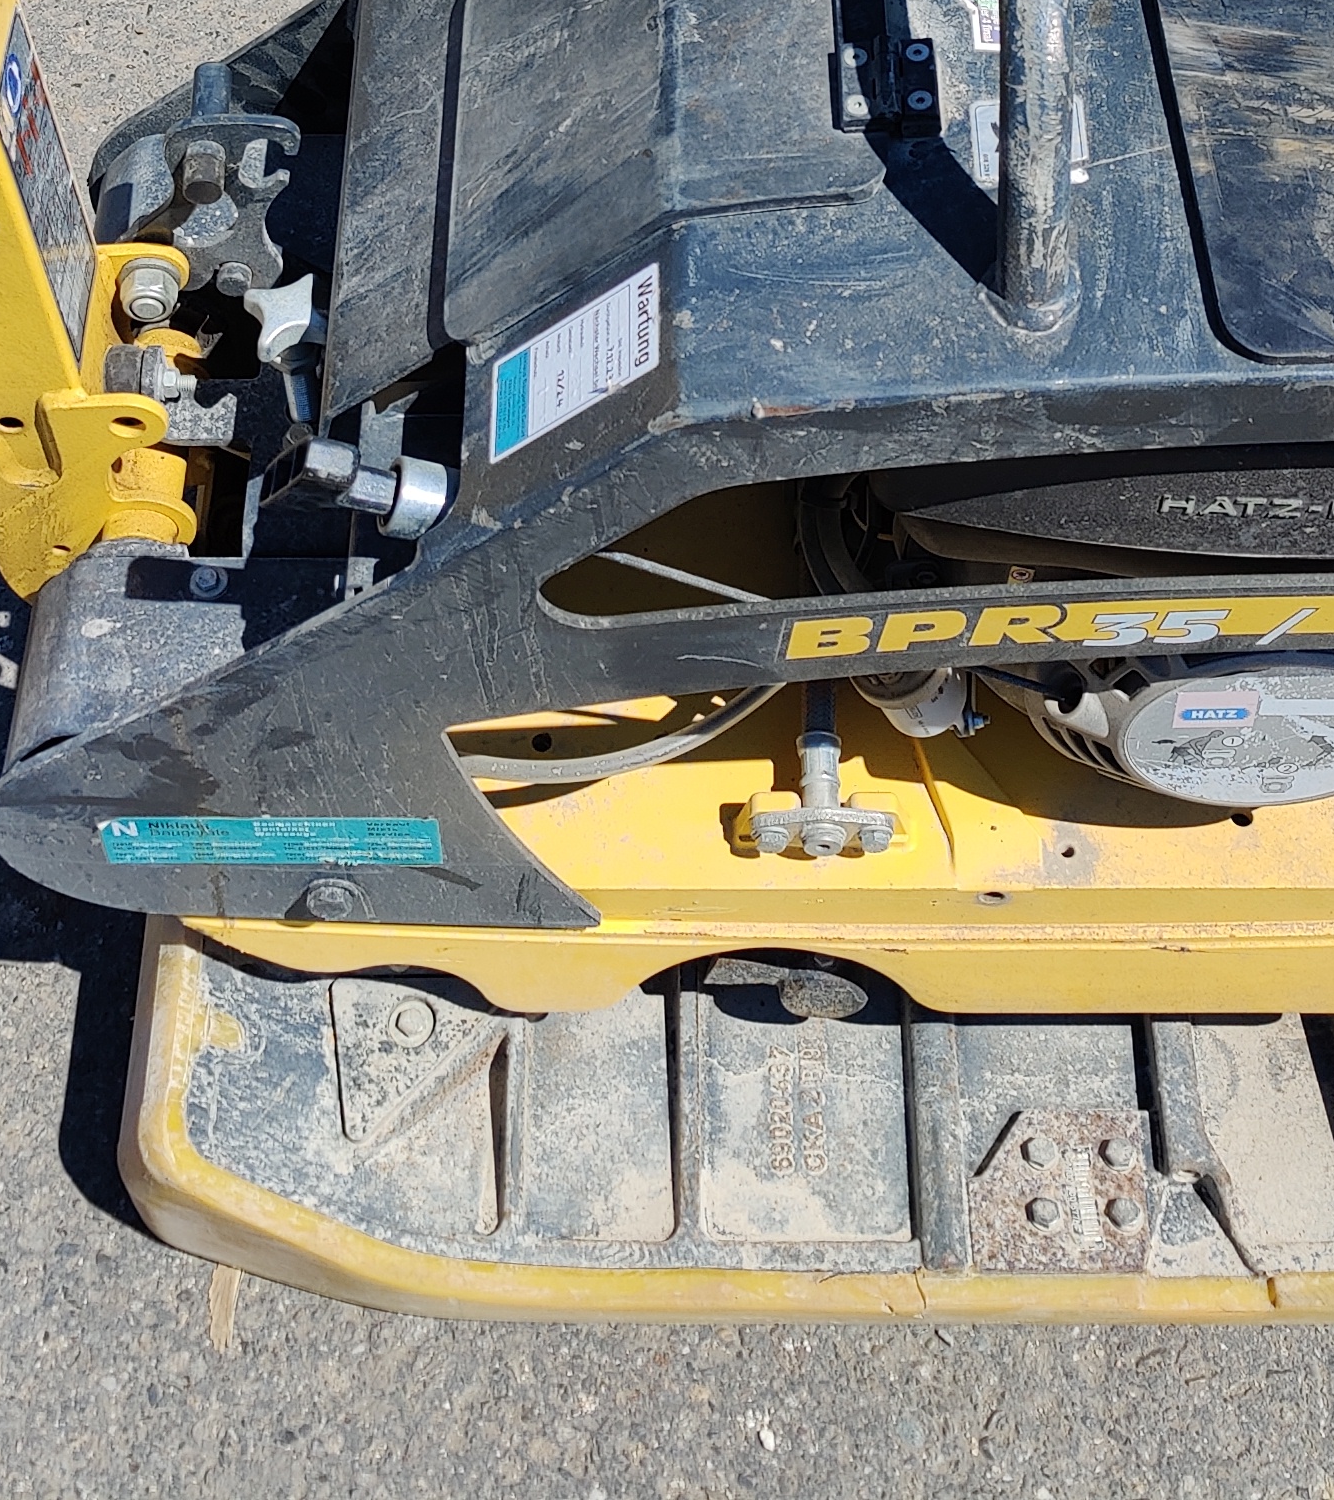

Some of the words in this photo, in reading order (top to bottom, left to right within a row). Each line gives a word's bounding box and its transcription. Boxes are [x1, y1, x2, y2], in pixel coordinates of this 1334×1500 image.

[634, 275, 654, 368] Wartung
[784, 602, 1068, 661] BPR
[1080, 607, 1232, 648] 35
[1256, 606, 1315, 646] /
[1191, 709, 1239, 720] HATZ
[111, 821, 139, 837] N
